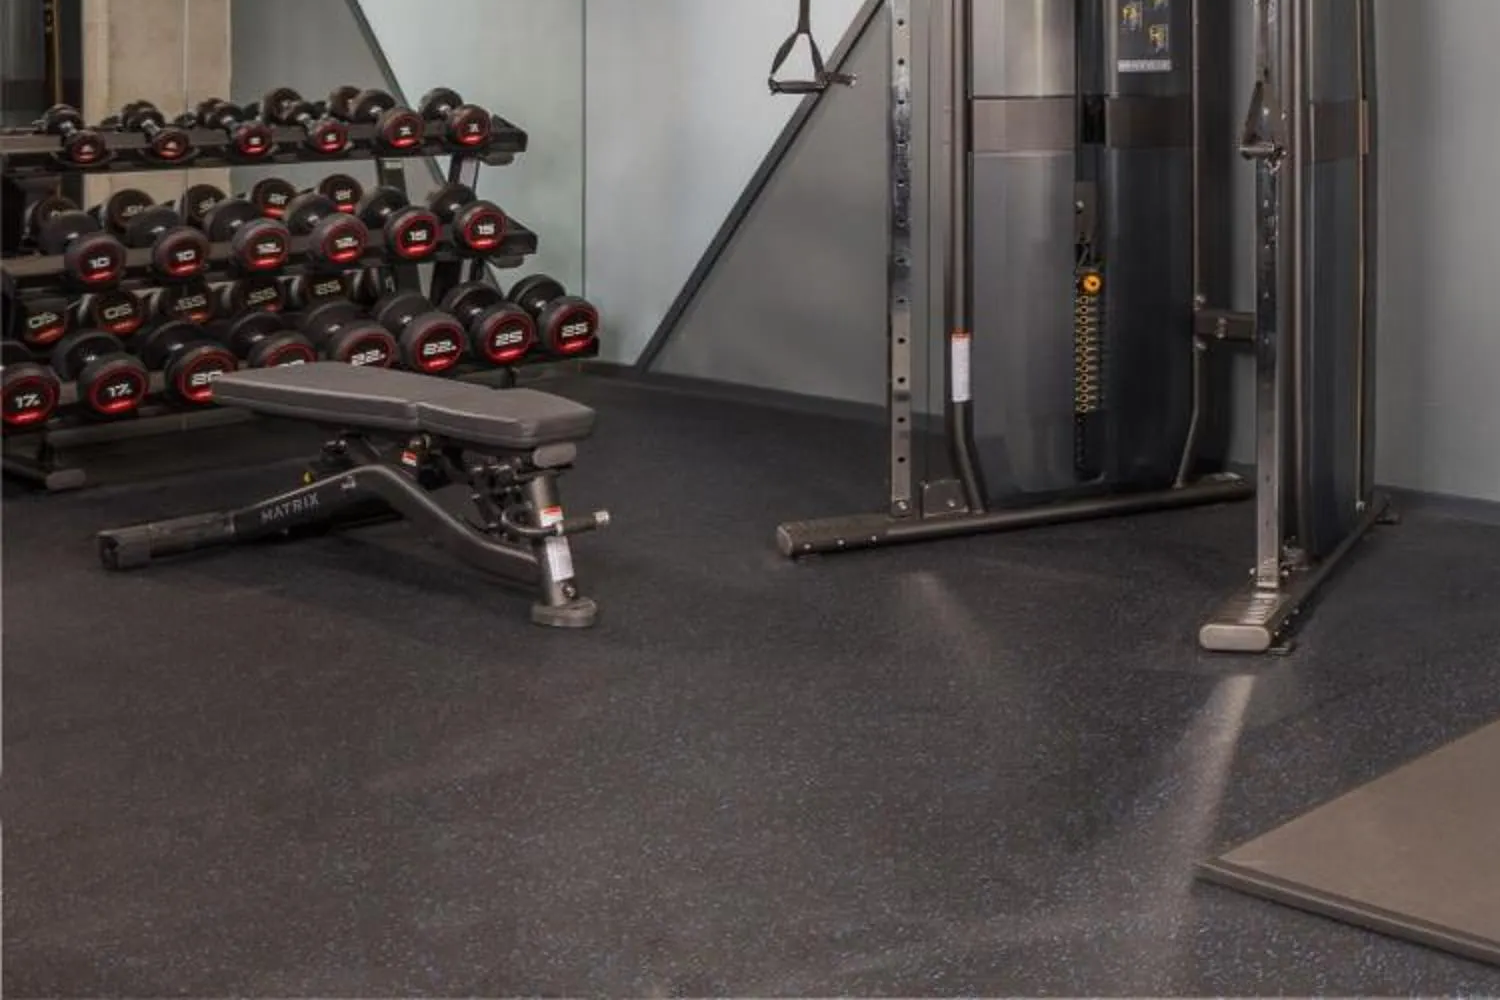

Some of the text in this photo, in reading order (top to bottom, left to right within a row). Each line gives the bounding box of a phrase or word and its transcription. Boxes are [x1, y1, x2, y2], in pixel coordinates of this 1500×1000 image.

[87, 255, 111, 269] 10
[175, 249, 196, 262] 10
[561, 321, 590, 338] 25
[495, 330, 524, 347] 25
